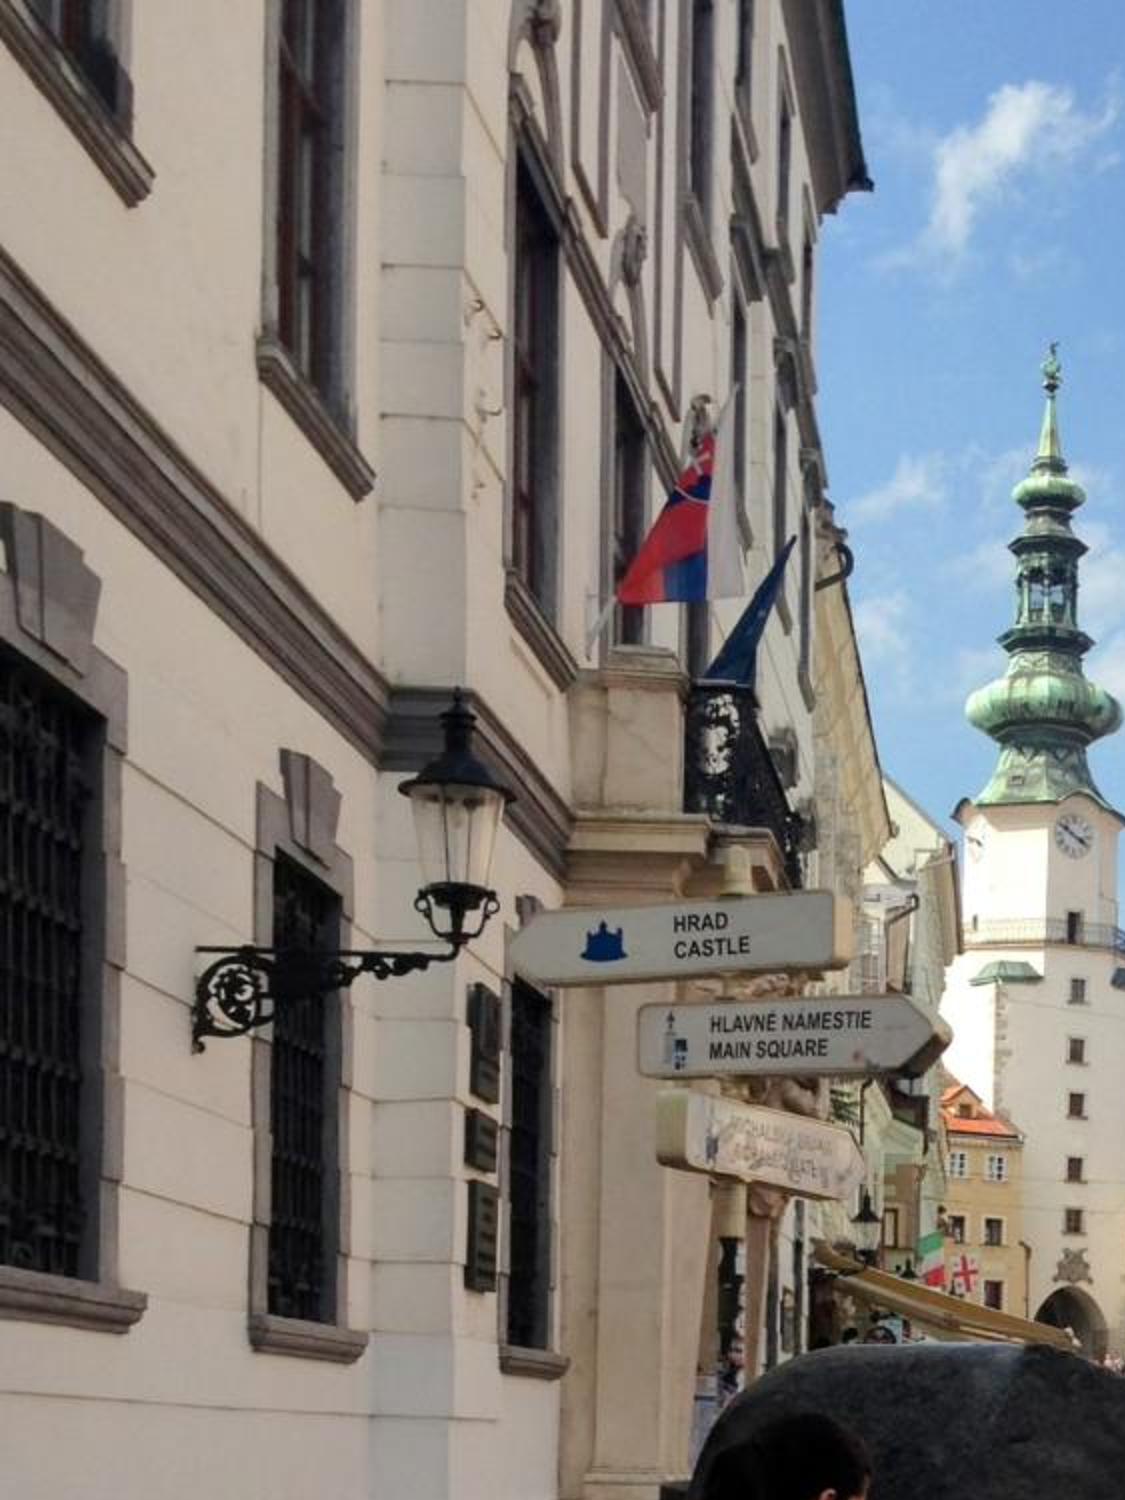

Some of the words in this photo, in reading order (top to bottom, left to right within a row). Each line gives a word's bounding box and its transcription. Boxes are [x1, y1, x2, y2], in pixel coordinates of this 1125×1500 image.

[673, 911, 729, 933] HRAD
[673, 935, 751, 959] CASTLE
[710, 1010, 777, 1033] HLAVNÉ
[709, 1041, 750, 1060] MAIN
[756, 1038, 829, 1059] SQUARE
